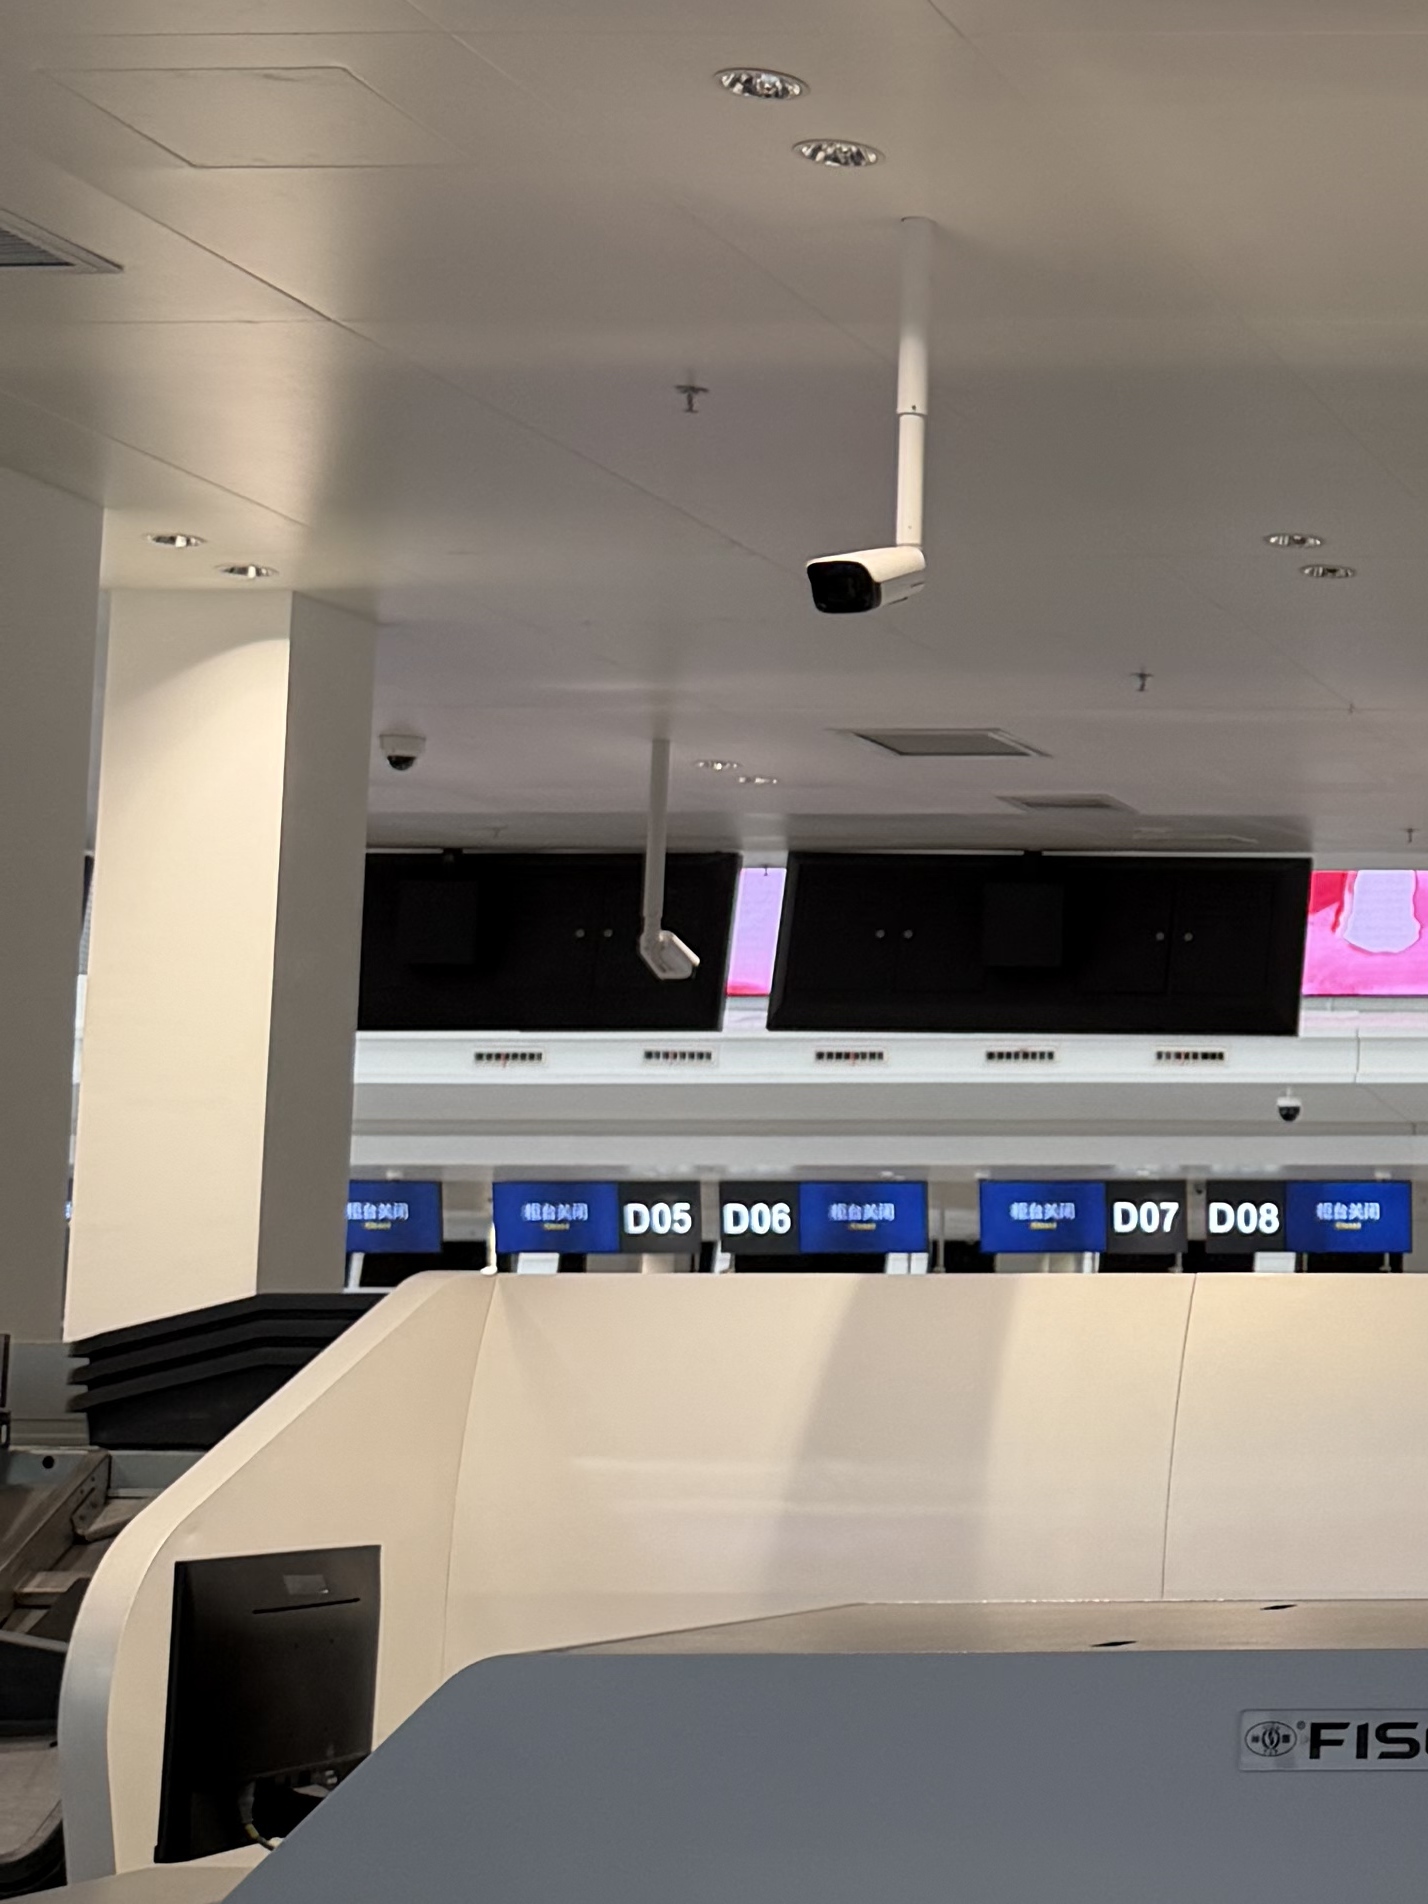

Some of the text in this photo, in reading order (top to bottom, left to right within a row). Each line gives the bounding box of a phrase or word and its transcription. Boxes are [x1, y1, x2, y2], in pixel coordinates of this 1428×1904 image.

[623, 1201, 693, 1236] D05
[722, 1201, 792, 1236] D06
[1112, 1201, 1180, 1236] D07
[1208, 1201, 1280, 1236] D08
